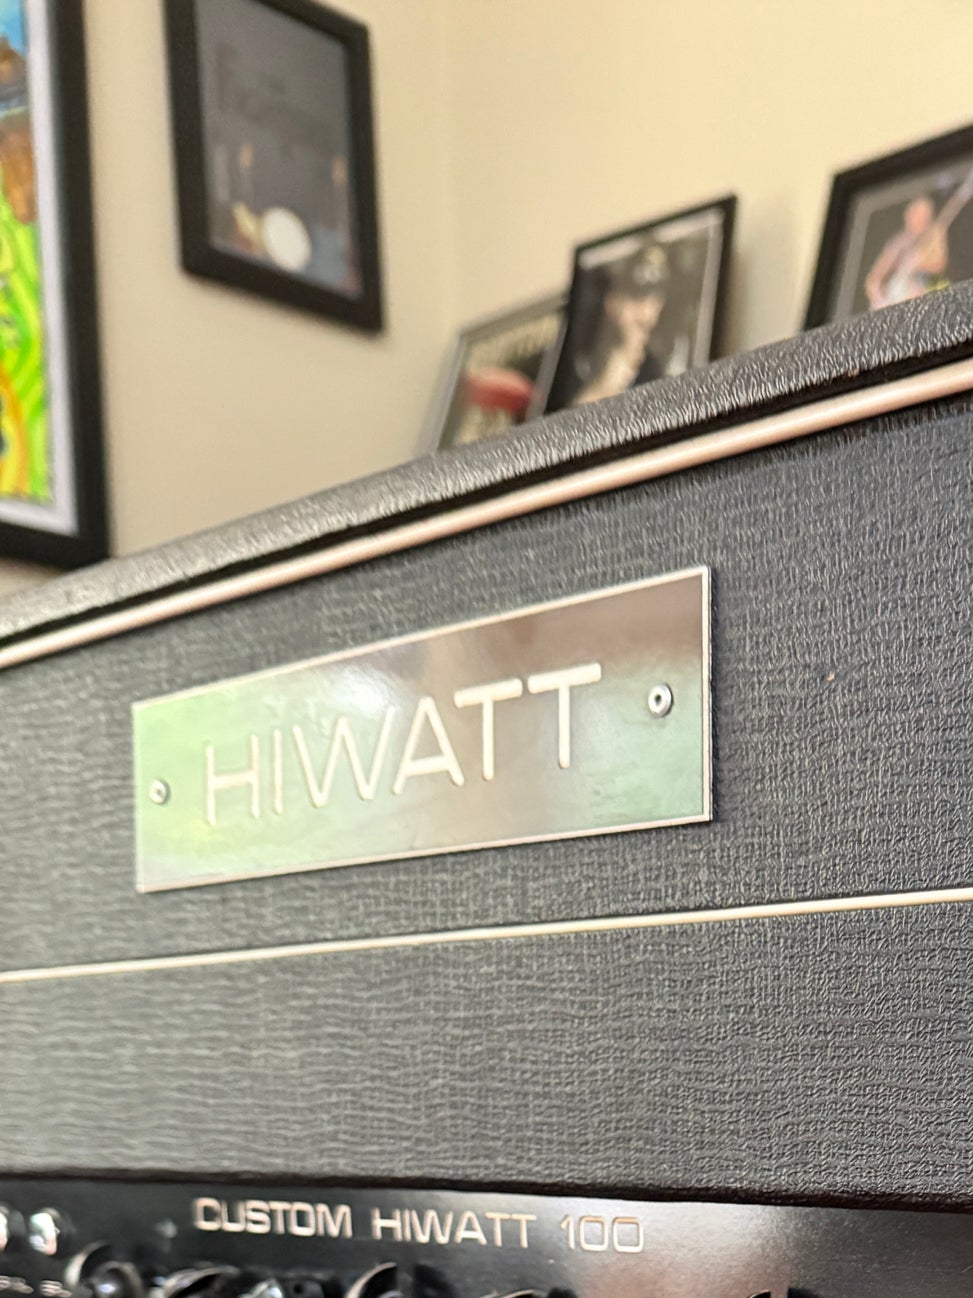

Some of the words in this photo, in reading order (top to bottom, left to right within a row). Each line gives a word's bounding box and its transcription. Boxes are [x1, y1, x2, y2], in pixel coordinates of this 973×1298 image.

[204, 661, 602, 827] HIWATT
[193, 1197, 353, 1238] CUSTOM
[371, 1207, 537, 1249] HIWATT
[560, 1214, 646, 1254] 100
